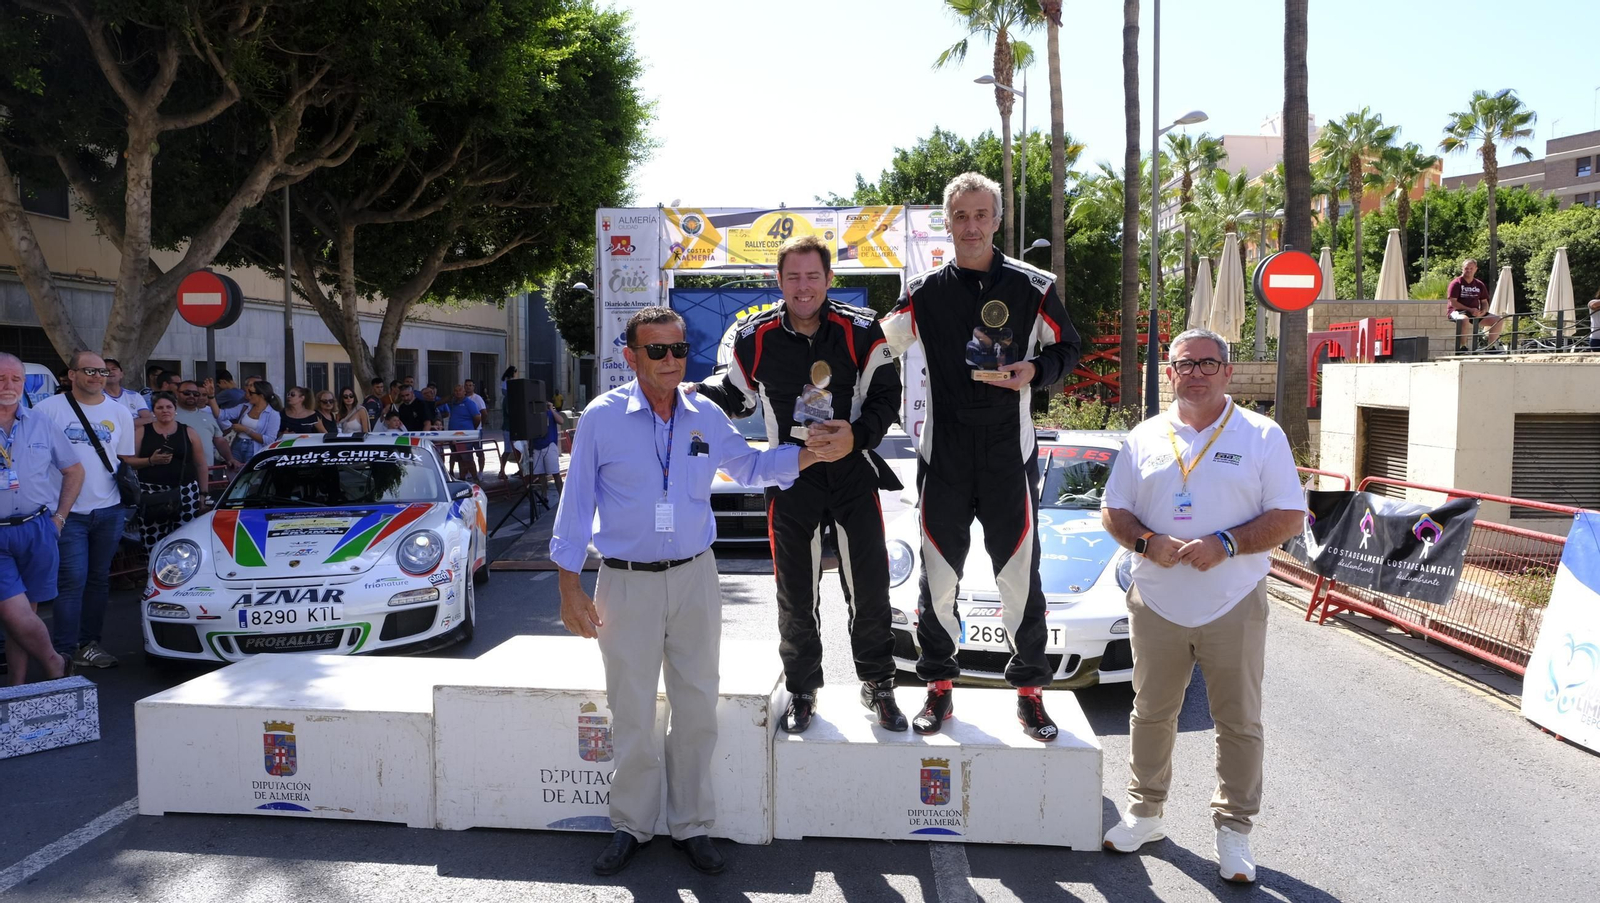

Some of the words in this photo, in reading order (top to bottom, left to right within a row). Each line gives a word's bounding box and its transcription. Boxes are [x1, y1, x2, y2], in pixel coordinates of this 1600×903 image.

[618, 215, 657, 224] ALMERÍA
[767, 217, 794, 239] 49
[745, 240, 766, 248] RALLYE
[766, 240, 784, 248] COST
[861, 244, 898, 252] DIPUTACIÓN
[682, 253, 715, 261] ALMERÍA
[1031, 276, 1048, 287] OMP
[602, 361, 625, 369] Isabel
[277, 450, 331, 463] André
[337, 450, 424, 462] CHIPEAUX
[275, 459, 317, 467] MOTOR
[364, 579, 409, 589] frionature
[230, 588, 345, 610] AZNAR
[251, 609, 297, 626] 8290
[307, 606, 341, 623] KTL
[969, 624, 1005, 644] 269
[245, 632, 336, 648] PRORALLYE
[540, 768, 614, 785] DPUTAC
[252, 781, 311, 791] DIPUTACIÓN
[254, 791, 267, 800] DE
[269, 791, 310, 801] ALMERÍA
[542, 788, 566, 804] DE
[571, 789, 610, 805] ALM
[907, 808, 962, 817] DIPUTACIÓN
[909, 818, 921, 826] DE
[923, 818, 961, 826] ALMERÍA
